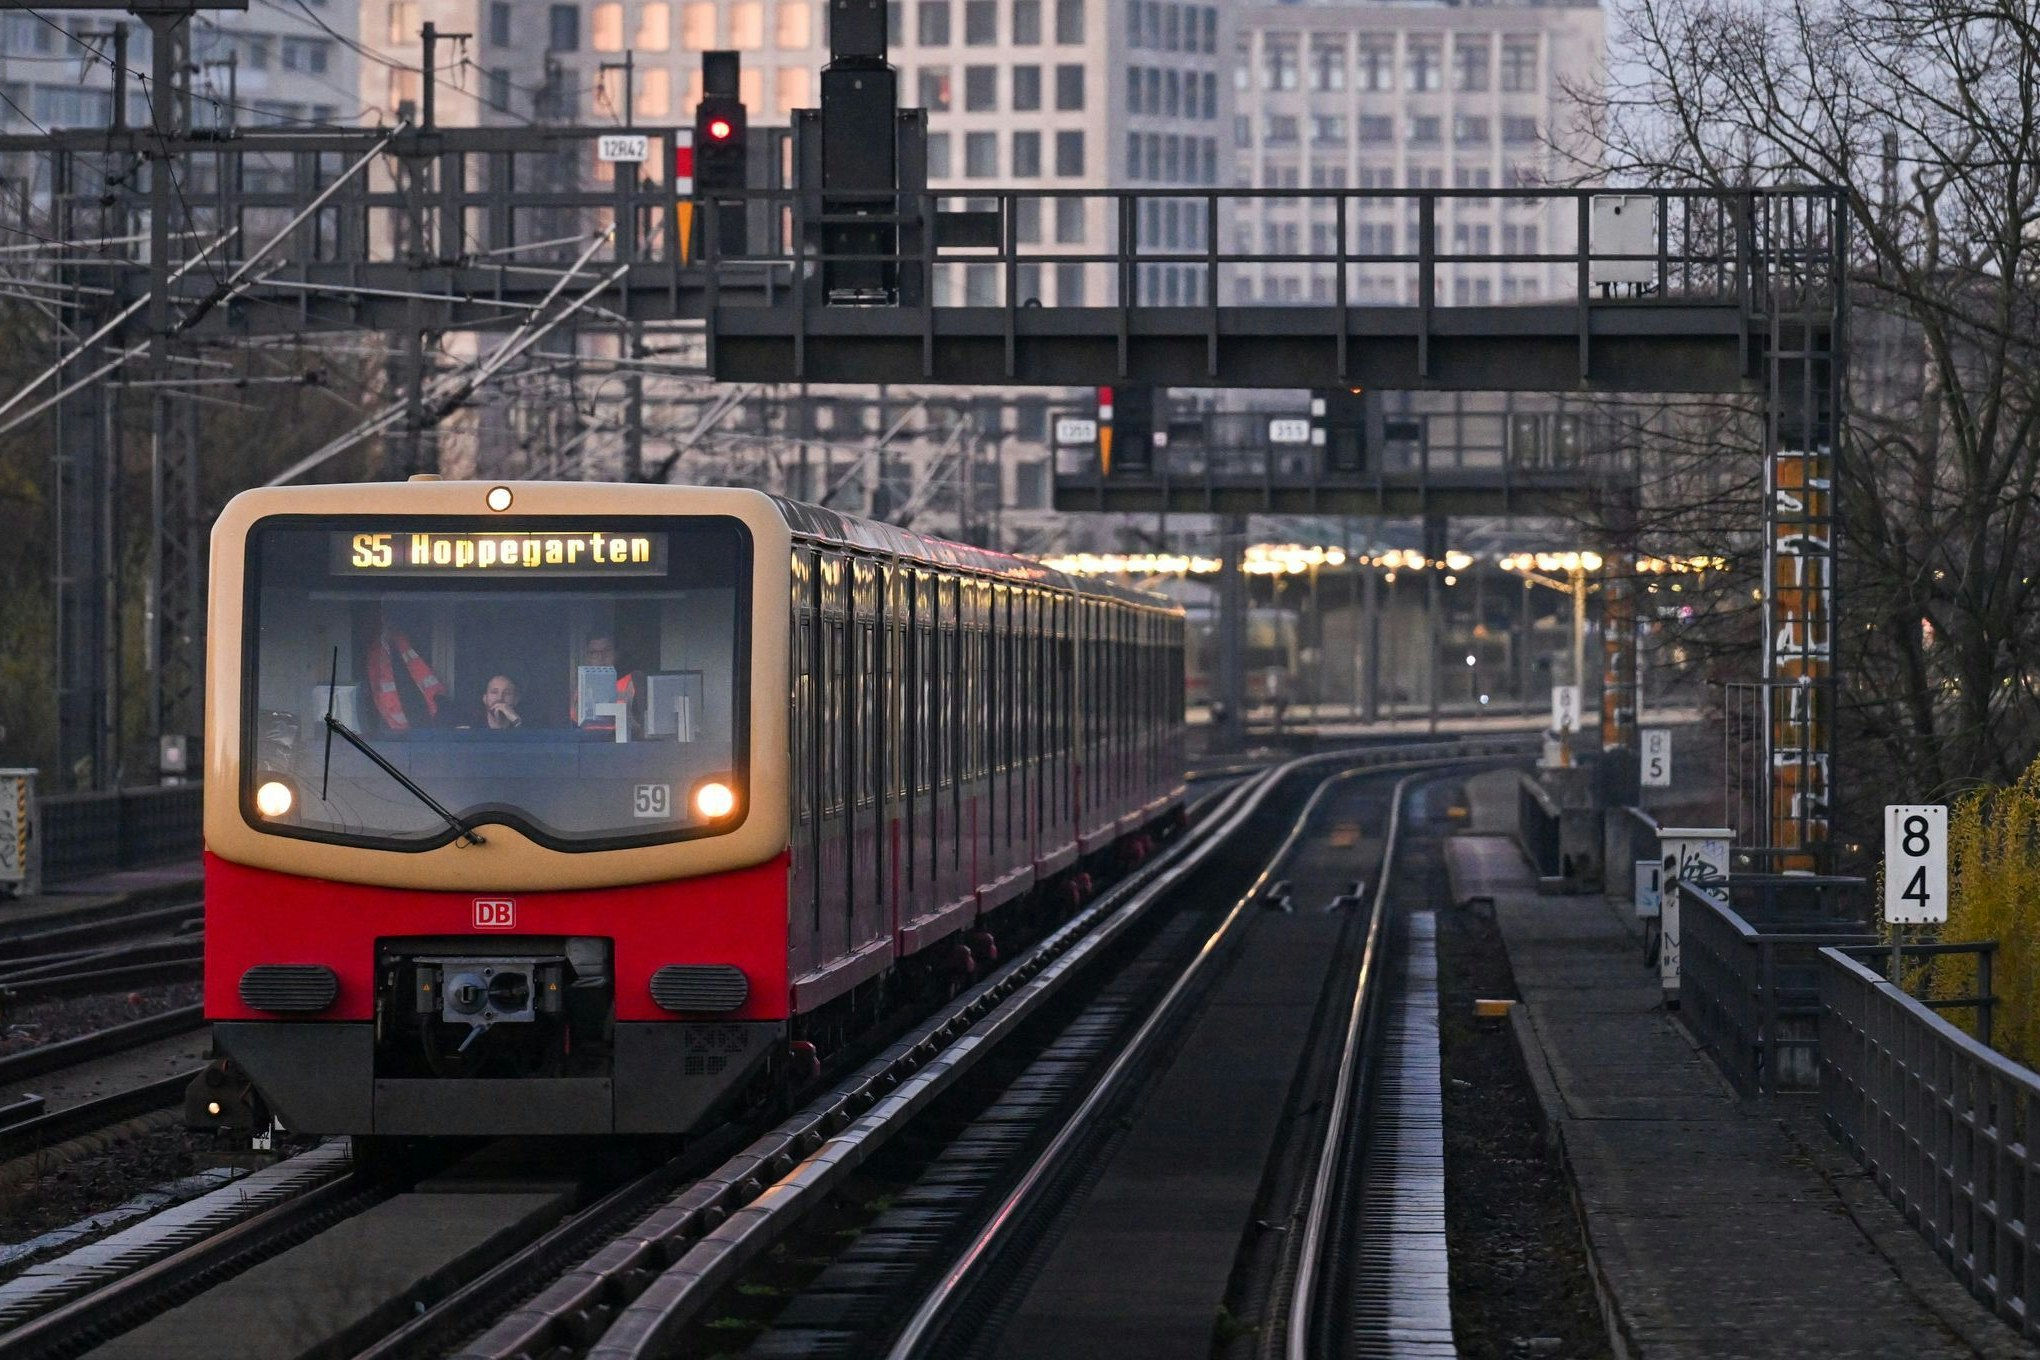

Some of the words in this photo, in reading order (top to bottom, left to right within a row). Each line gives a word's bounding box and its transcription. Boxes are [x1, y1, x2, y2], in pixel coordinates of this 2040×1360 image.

[603, 140, 645, 157] 12R42
[352, 533, 392, 568] S5
[411, 532, 650, 568] Hoppegarten
[1650, 757, 1662, 778] 5
[636, 785, 666, 812] 59
[1902, 815, 1930, 857] 8
[1901, 866, 1930, 907] 4
[478, 902, 511, 924] DB
